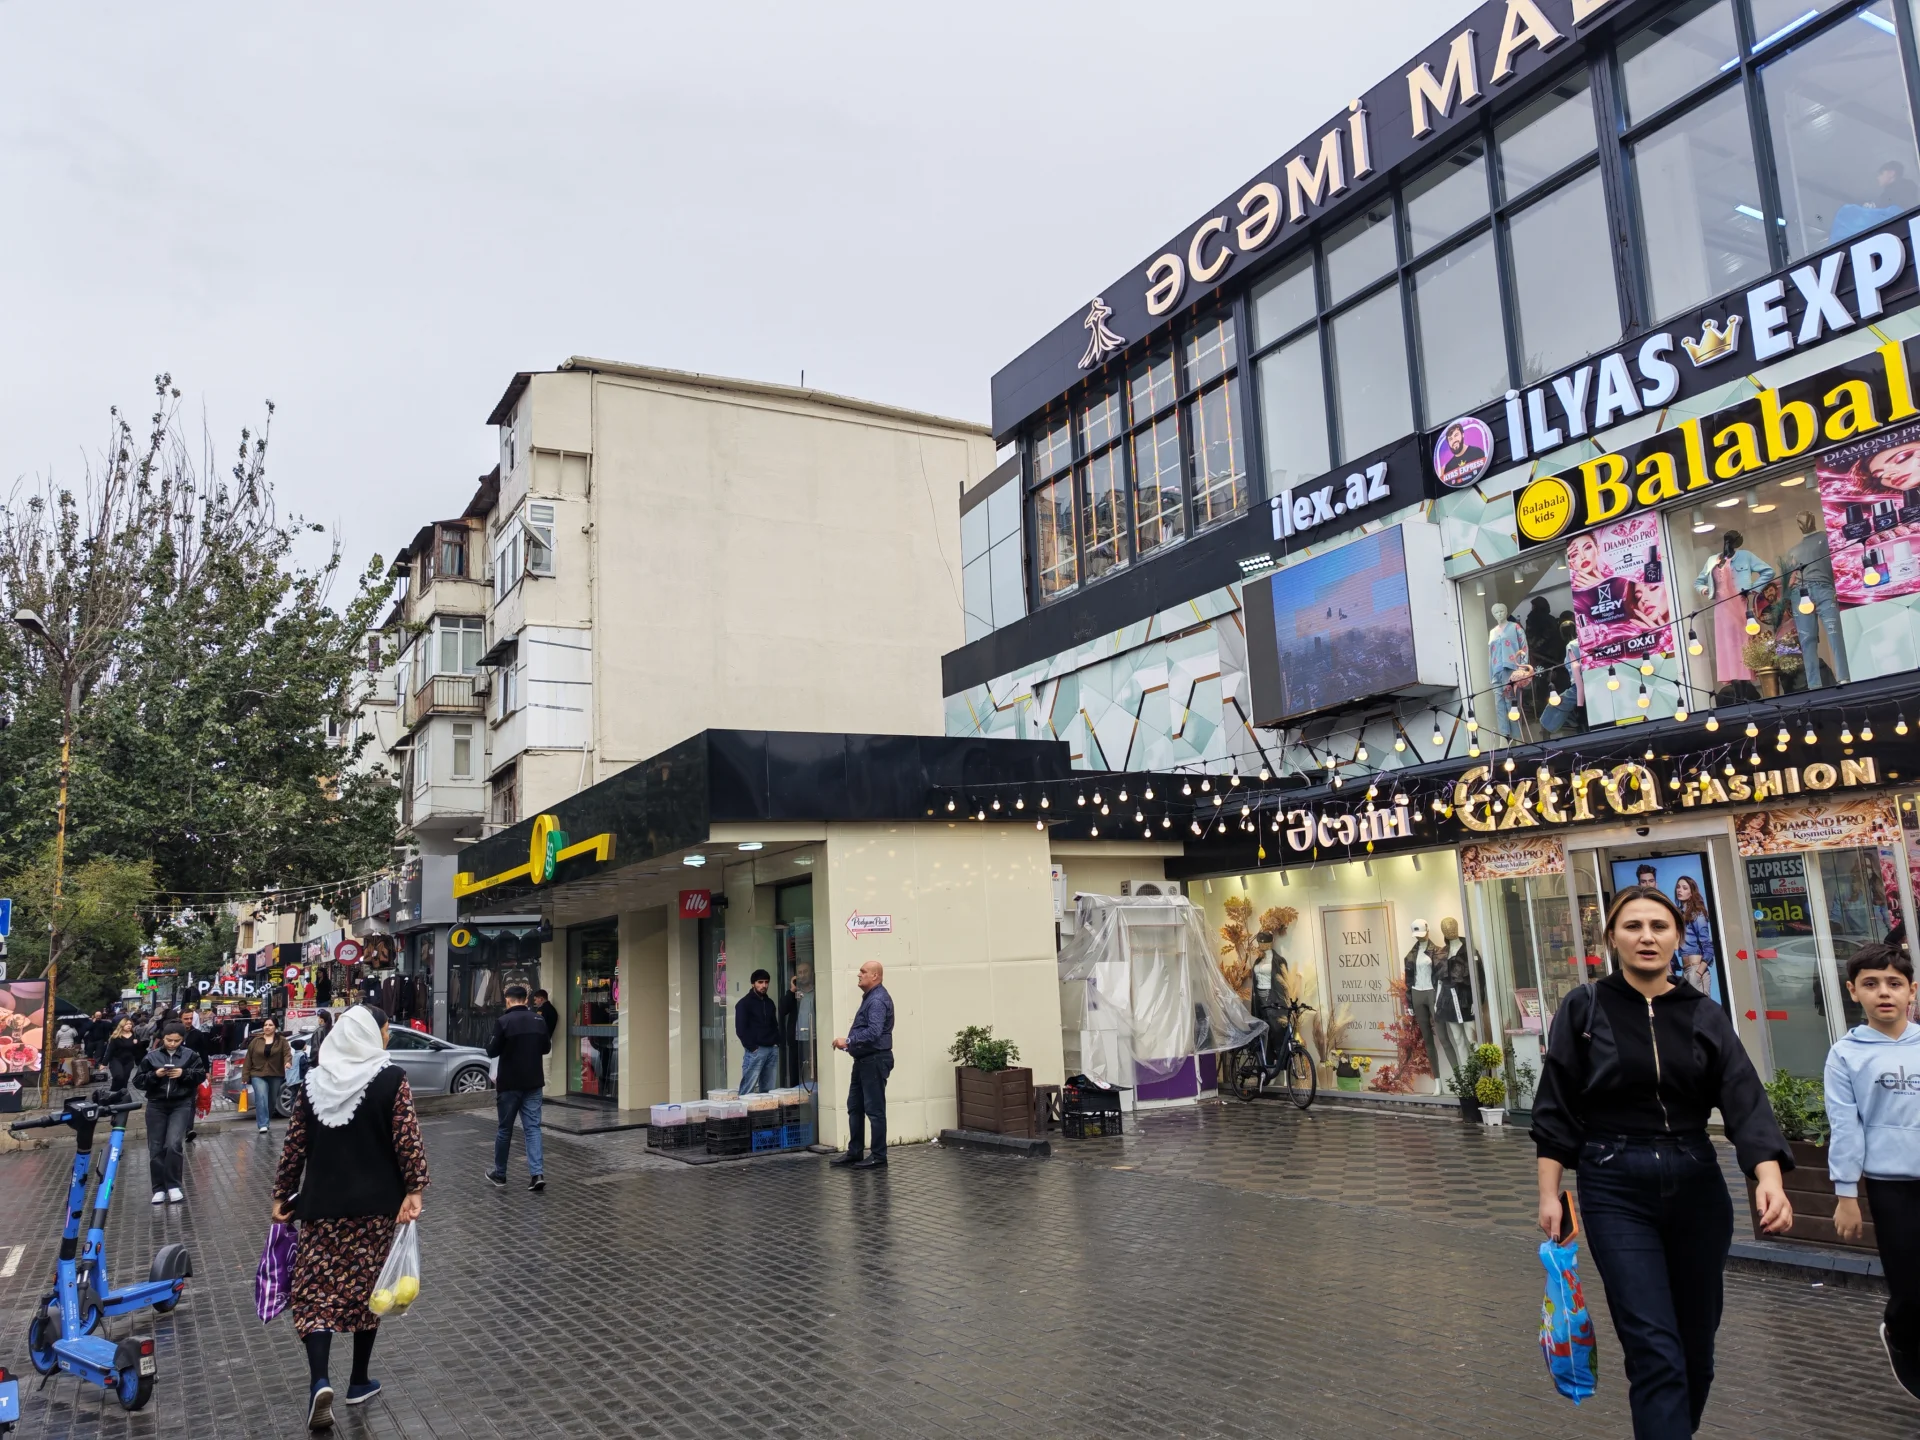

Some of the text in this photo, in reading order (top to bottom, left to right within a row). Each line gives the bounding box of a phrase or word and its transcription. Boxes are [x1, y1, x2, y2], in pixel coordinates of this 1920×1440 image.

[1145, 0, 1612, 316] ƏCƏMİ MA
[1505, 215, 1920, 462] İLYAS EXP
[1823, 433, 1899, 463] DIAMOND
[1829, 434, 1920, 467] MASTER SERI
[1271, 462, 1390, 541] ilex.az
[1522, 495, 1566, 516] Balabala
[1534, 511, 1555, 524] kids
[1603, 528, 1656, 552] DIAMOND PRO
[1590, 599, 1623, 616] ZERY
[1627, 634, 1656, 649] OXXI
[1454, 756, 1877, 832] Extra FASHION
[1774, 813, 1867, 833] DIAMOND PRO
[1793, 828, 1843, 840] Kosmetika
[1481, 848, 1543, 864] DIAMOND PRO
[1748, 859, 1803, 878] EXPRESS
[685, 894, 708, 913] illy
[1342, 929, 1372, 945] YENİ
[341, 947, 356, 955] nar
[1338, 953, 1380, 968] SEZON
[1342, 980, 1362, 989] PAYIZ
[1337, 992, 1390, 1003] KOLLEKSİYASI
[110, 1146, 120, 1162] JET
